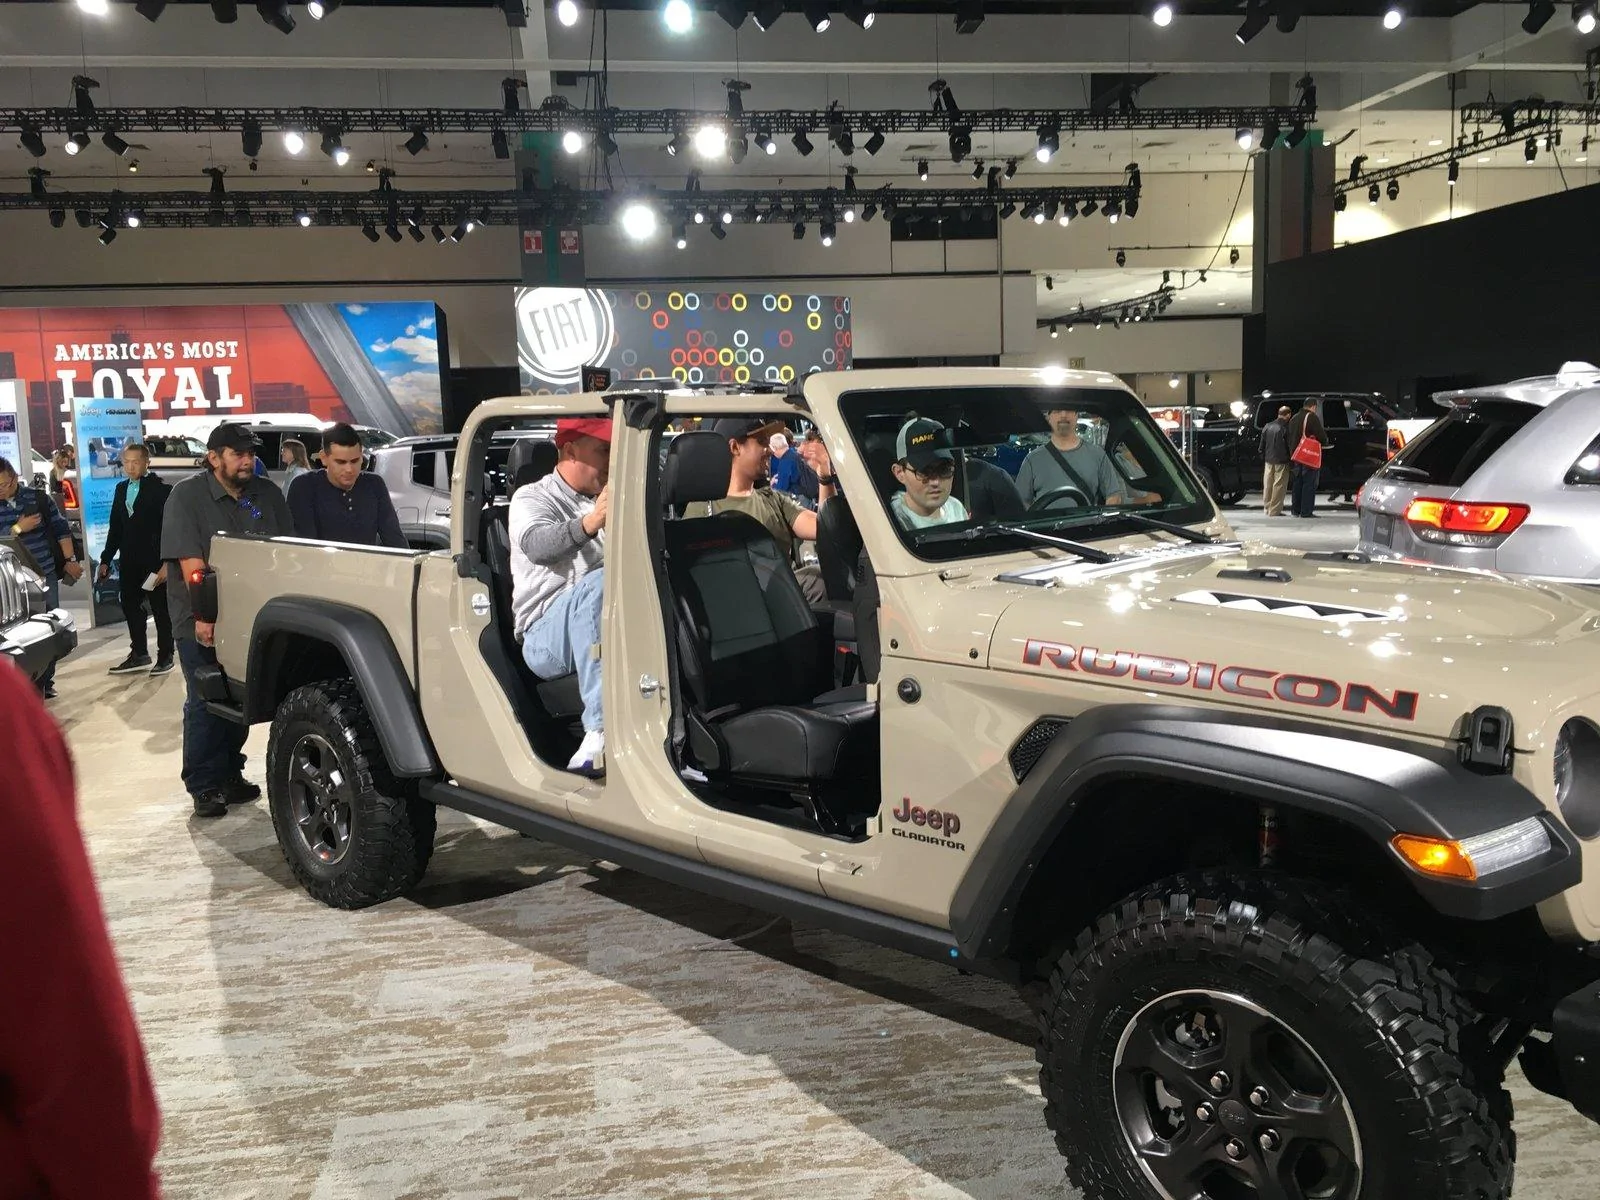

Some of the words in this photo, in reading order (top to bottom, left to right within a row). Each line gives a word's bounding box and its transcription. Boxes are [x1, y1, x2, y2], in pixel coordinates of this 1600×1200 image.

[528, 297, 588, 355] FIAT
[54, 341, 175, 362] AMERICA'S
[182, 341, 239, 359] MOST
[1022, 638, 1420, 721] RUBICON
[892, 796, 961, 838] Jeep
[891, 827, 966, 852] GLADIATOR
